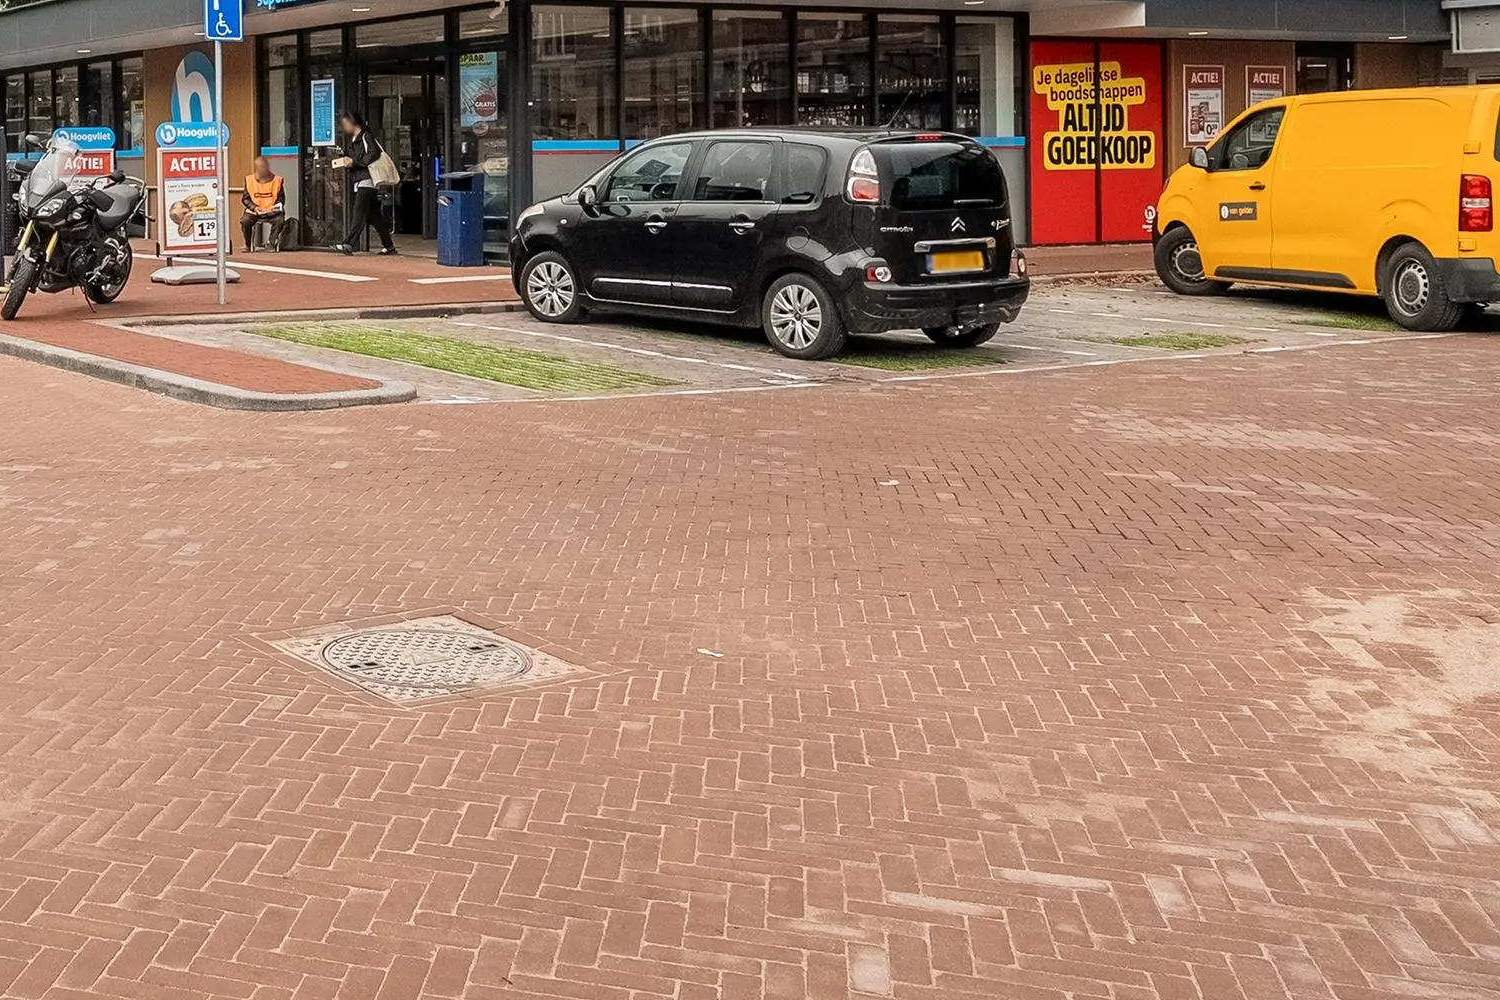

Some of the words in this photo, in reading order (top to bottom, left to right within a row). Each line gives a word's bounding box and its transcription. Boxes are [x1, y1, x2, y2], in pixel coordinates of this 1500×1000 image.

[1037, 70, 1052, 85] Je
[1190, 72, 1219, 84] ACTIE!
[1253, 72, 1280, 84] ACTIE!
[70, 131, 111, 142] Hoogvliet
[177, 127, 225, 139] Hoogvli
[1047, 135, 1152, 165] GOEDKOOP
[64, 157, 104, 170] ACTIE!
[169, 156, 216, 172] ACTIE!
[197, 221, 216, 237] 1.29
